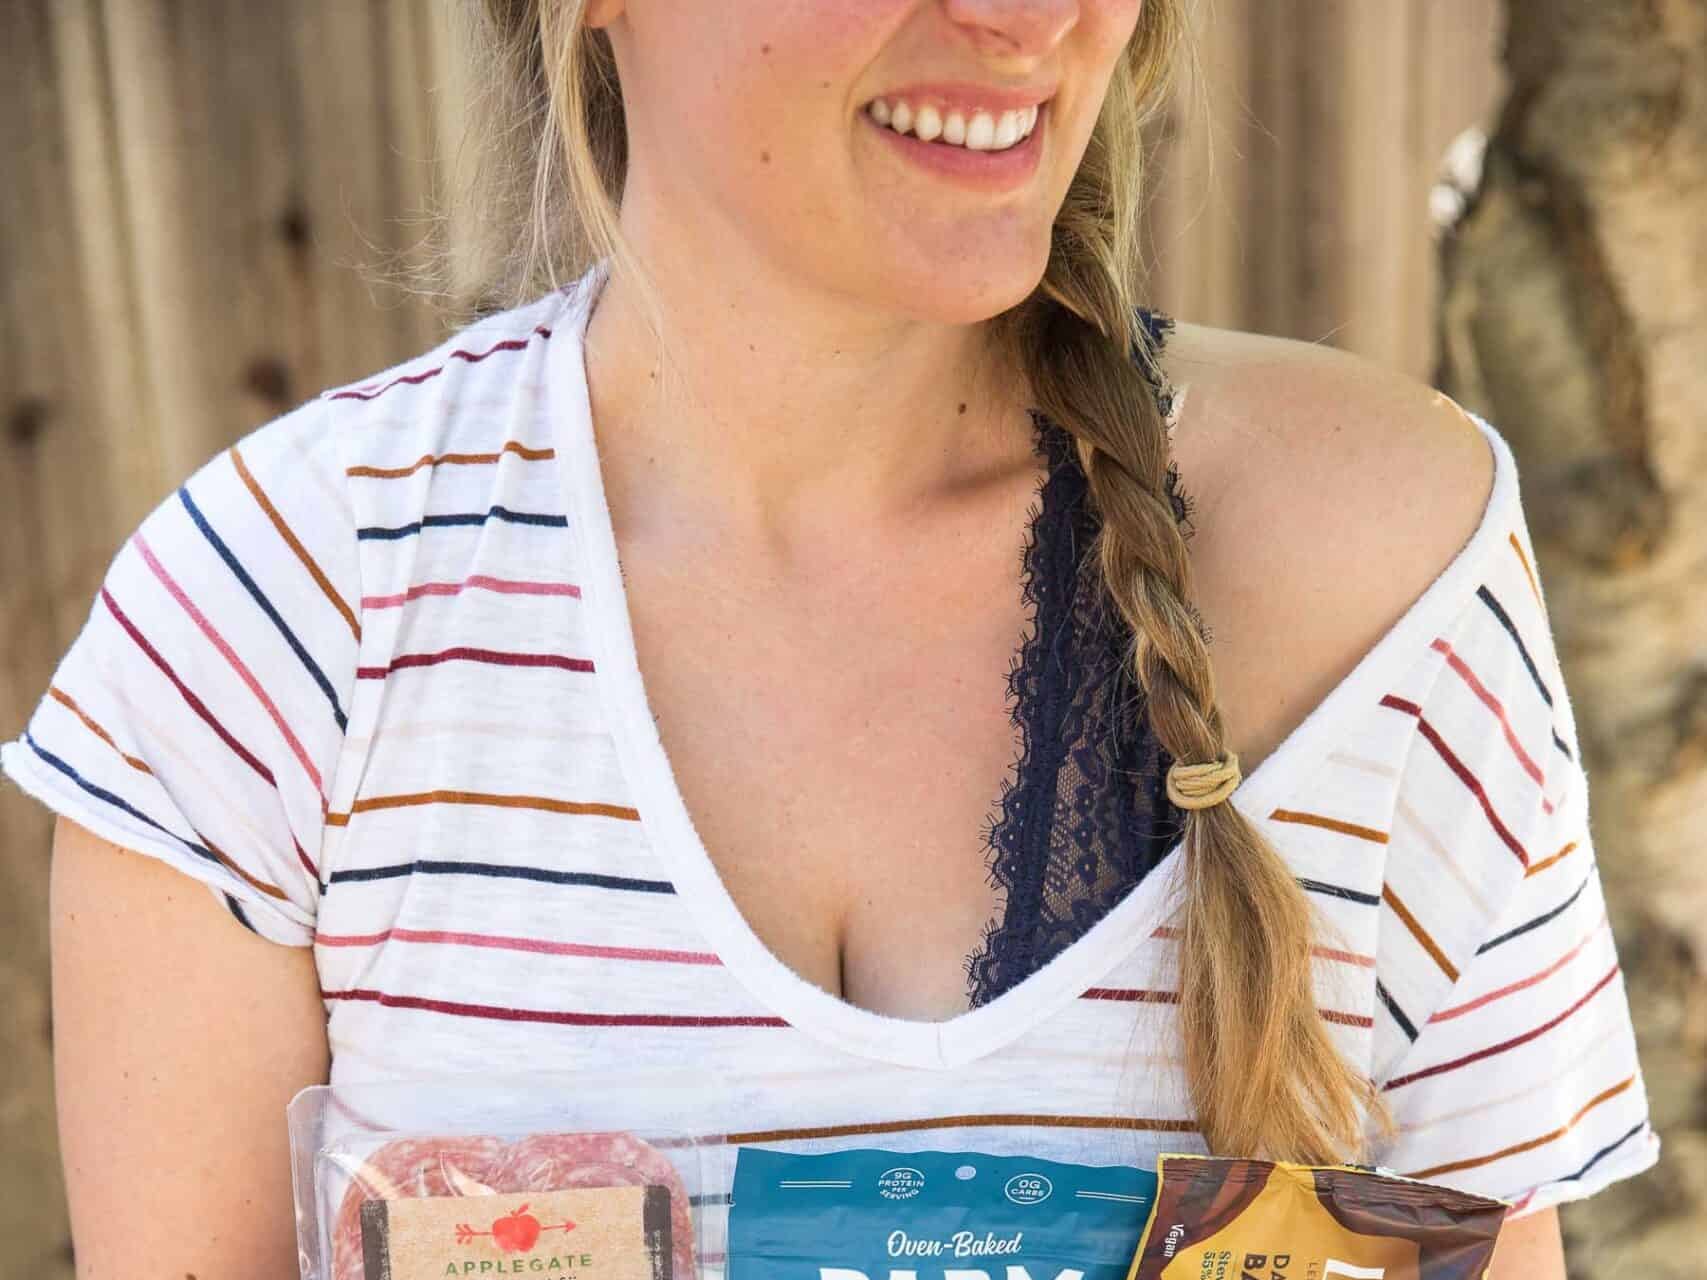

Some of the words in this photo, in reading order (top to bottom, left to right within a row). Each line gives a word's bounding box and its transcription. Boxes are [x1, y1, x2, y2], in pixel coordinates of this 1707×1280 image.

[878, 1179, 925, 1188] PROTEIN
[880, 1188, 919, 1200] SERVING
[1010, 1187, 1045, 1197] CARBS
[887, 1230, 1022, 1259] Oven-Baked
[1163, 1223, 1185, 1257] Vegan
[446, 1254, 592, 1275] APPLEGATE
[1200, 1251, 1216, 1280] 55%
